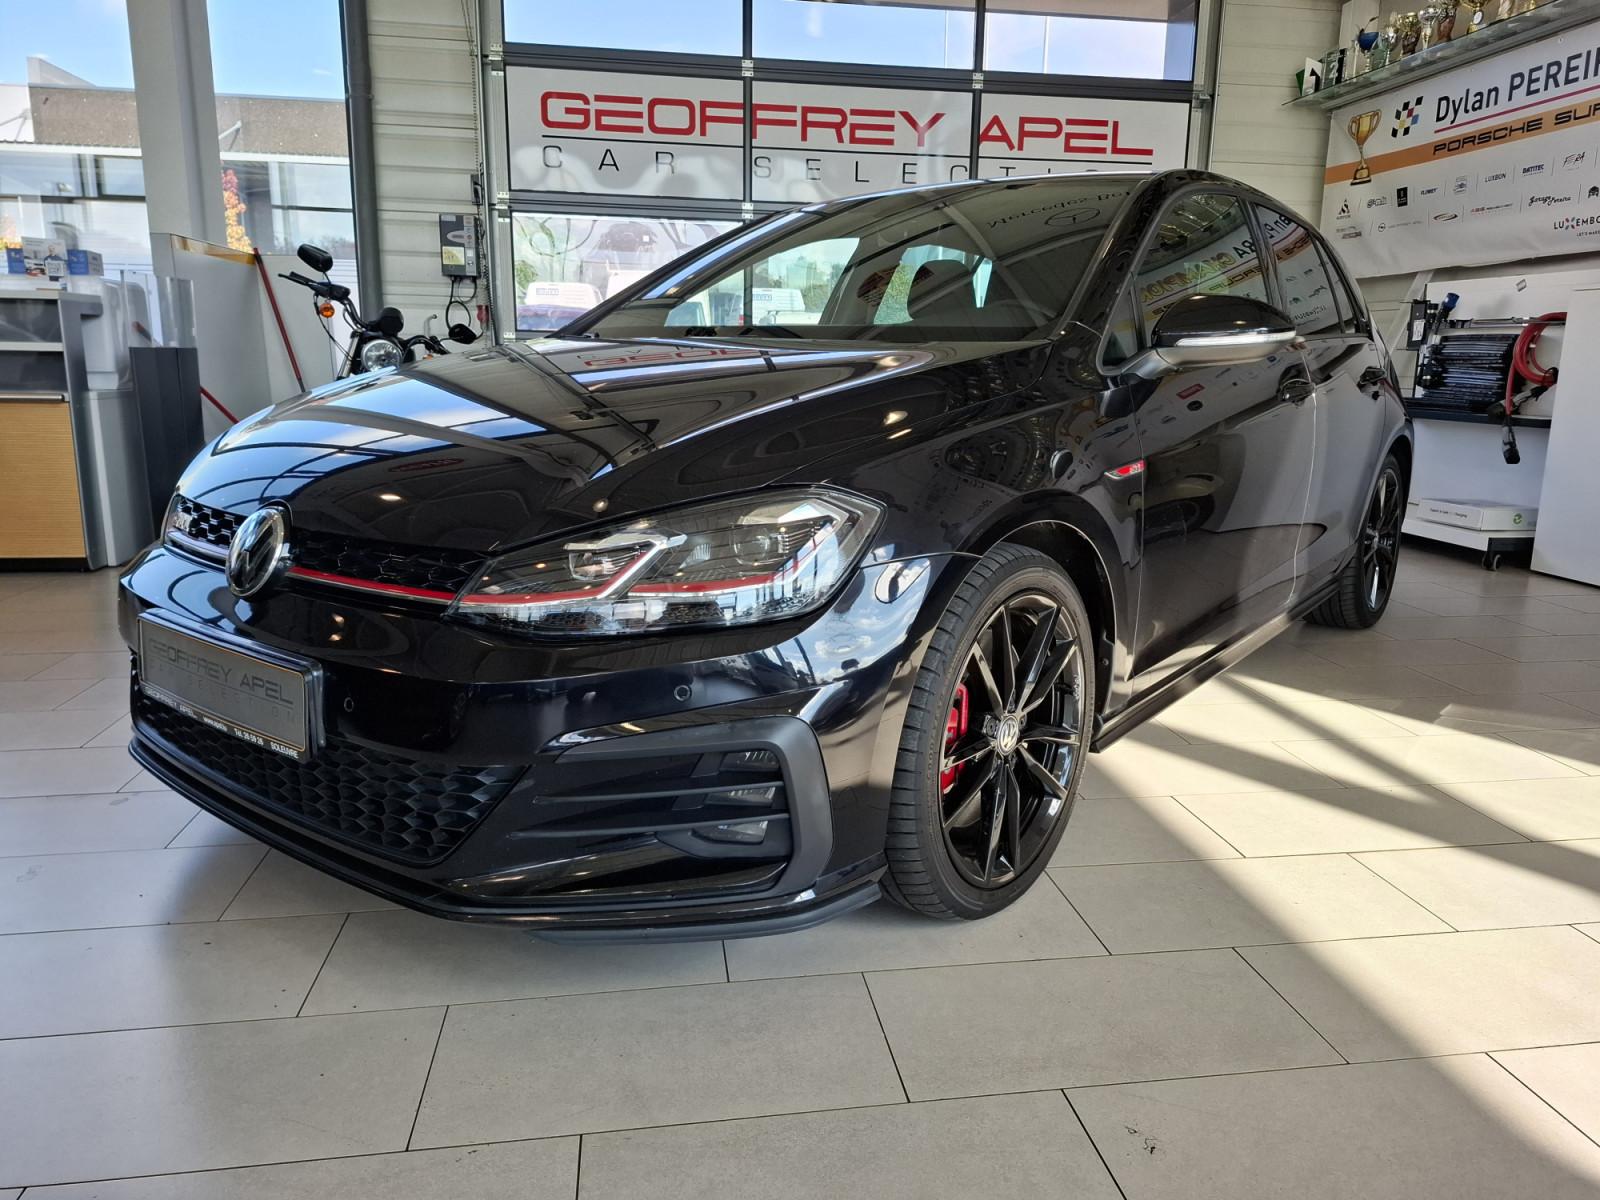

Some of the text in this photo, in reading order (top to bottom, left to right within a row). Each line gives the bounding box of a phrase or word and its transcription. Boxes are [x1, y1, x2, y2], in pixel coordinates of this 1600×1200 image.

[540, 90, 1154, 157] GEOFFREY APEL
[1435, 86, 1499, 124] Dylan
[1433, 117, 1543, 155] PORSCHE
[541, 145, 677, 175] CAR
[240, 673, 294, 705] APEL
